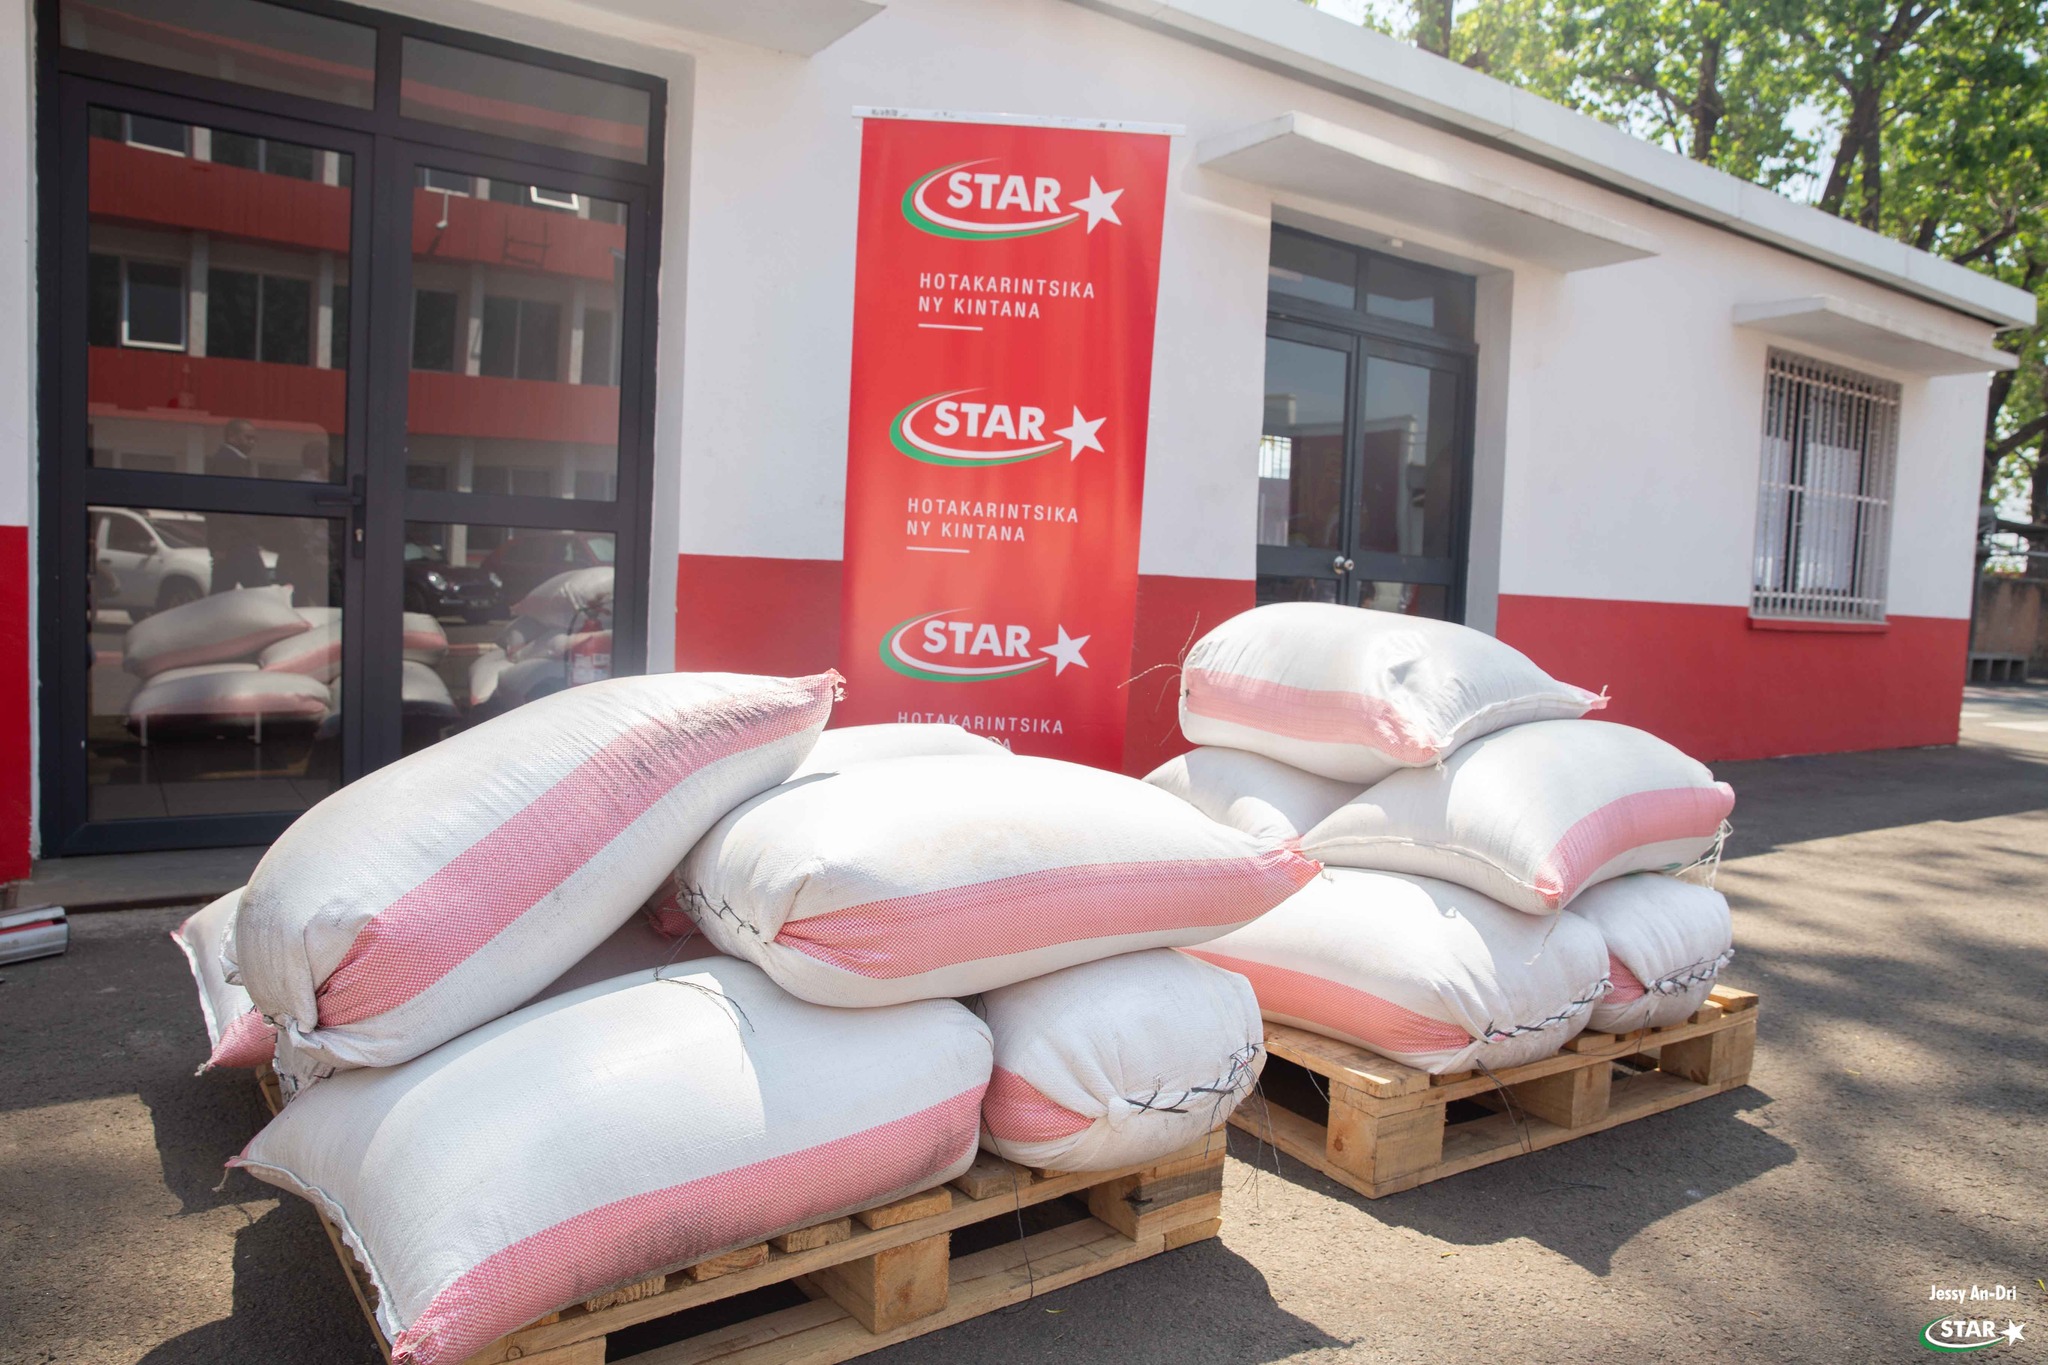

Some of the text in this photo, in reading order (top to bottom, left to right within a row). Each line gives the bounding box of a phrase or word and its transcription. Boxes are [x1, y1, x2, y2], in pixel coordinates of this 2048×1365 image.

[947, 171, 1061, 214] STAR
[919, 272, 1095, 299] HOTAKARINTSIKA
[918, 295, 1040, 319] NY KINTANA
[933, 400, 1045, 442] STAR
[907, 497, 1078, 523] HOTAKARINTSIKA
[906, 519, 1025, 542] NY KINTANA
[922, 620, 1031, 658] STAR
[897, 711, 1063, 734] HOTAKARINTSIKA
